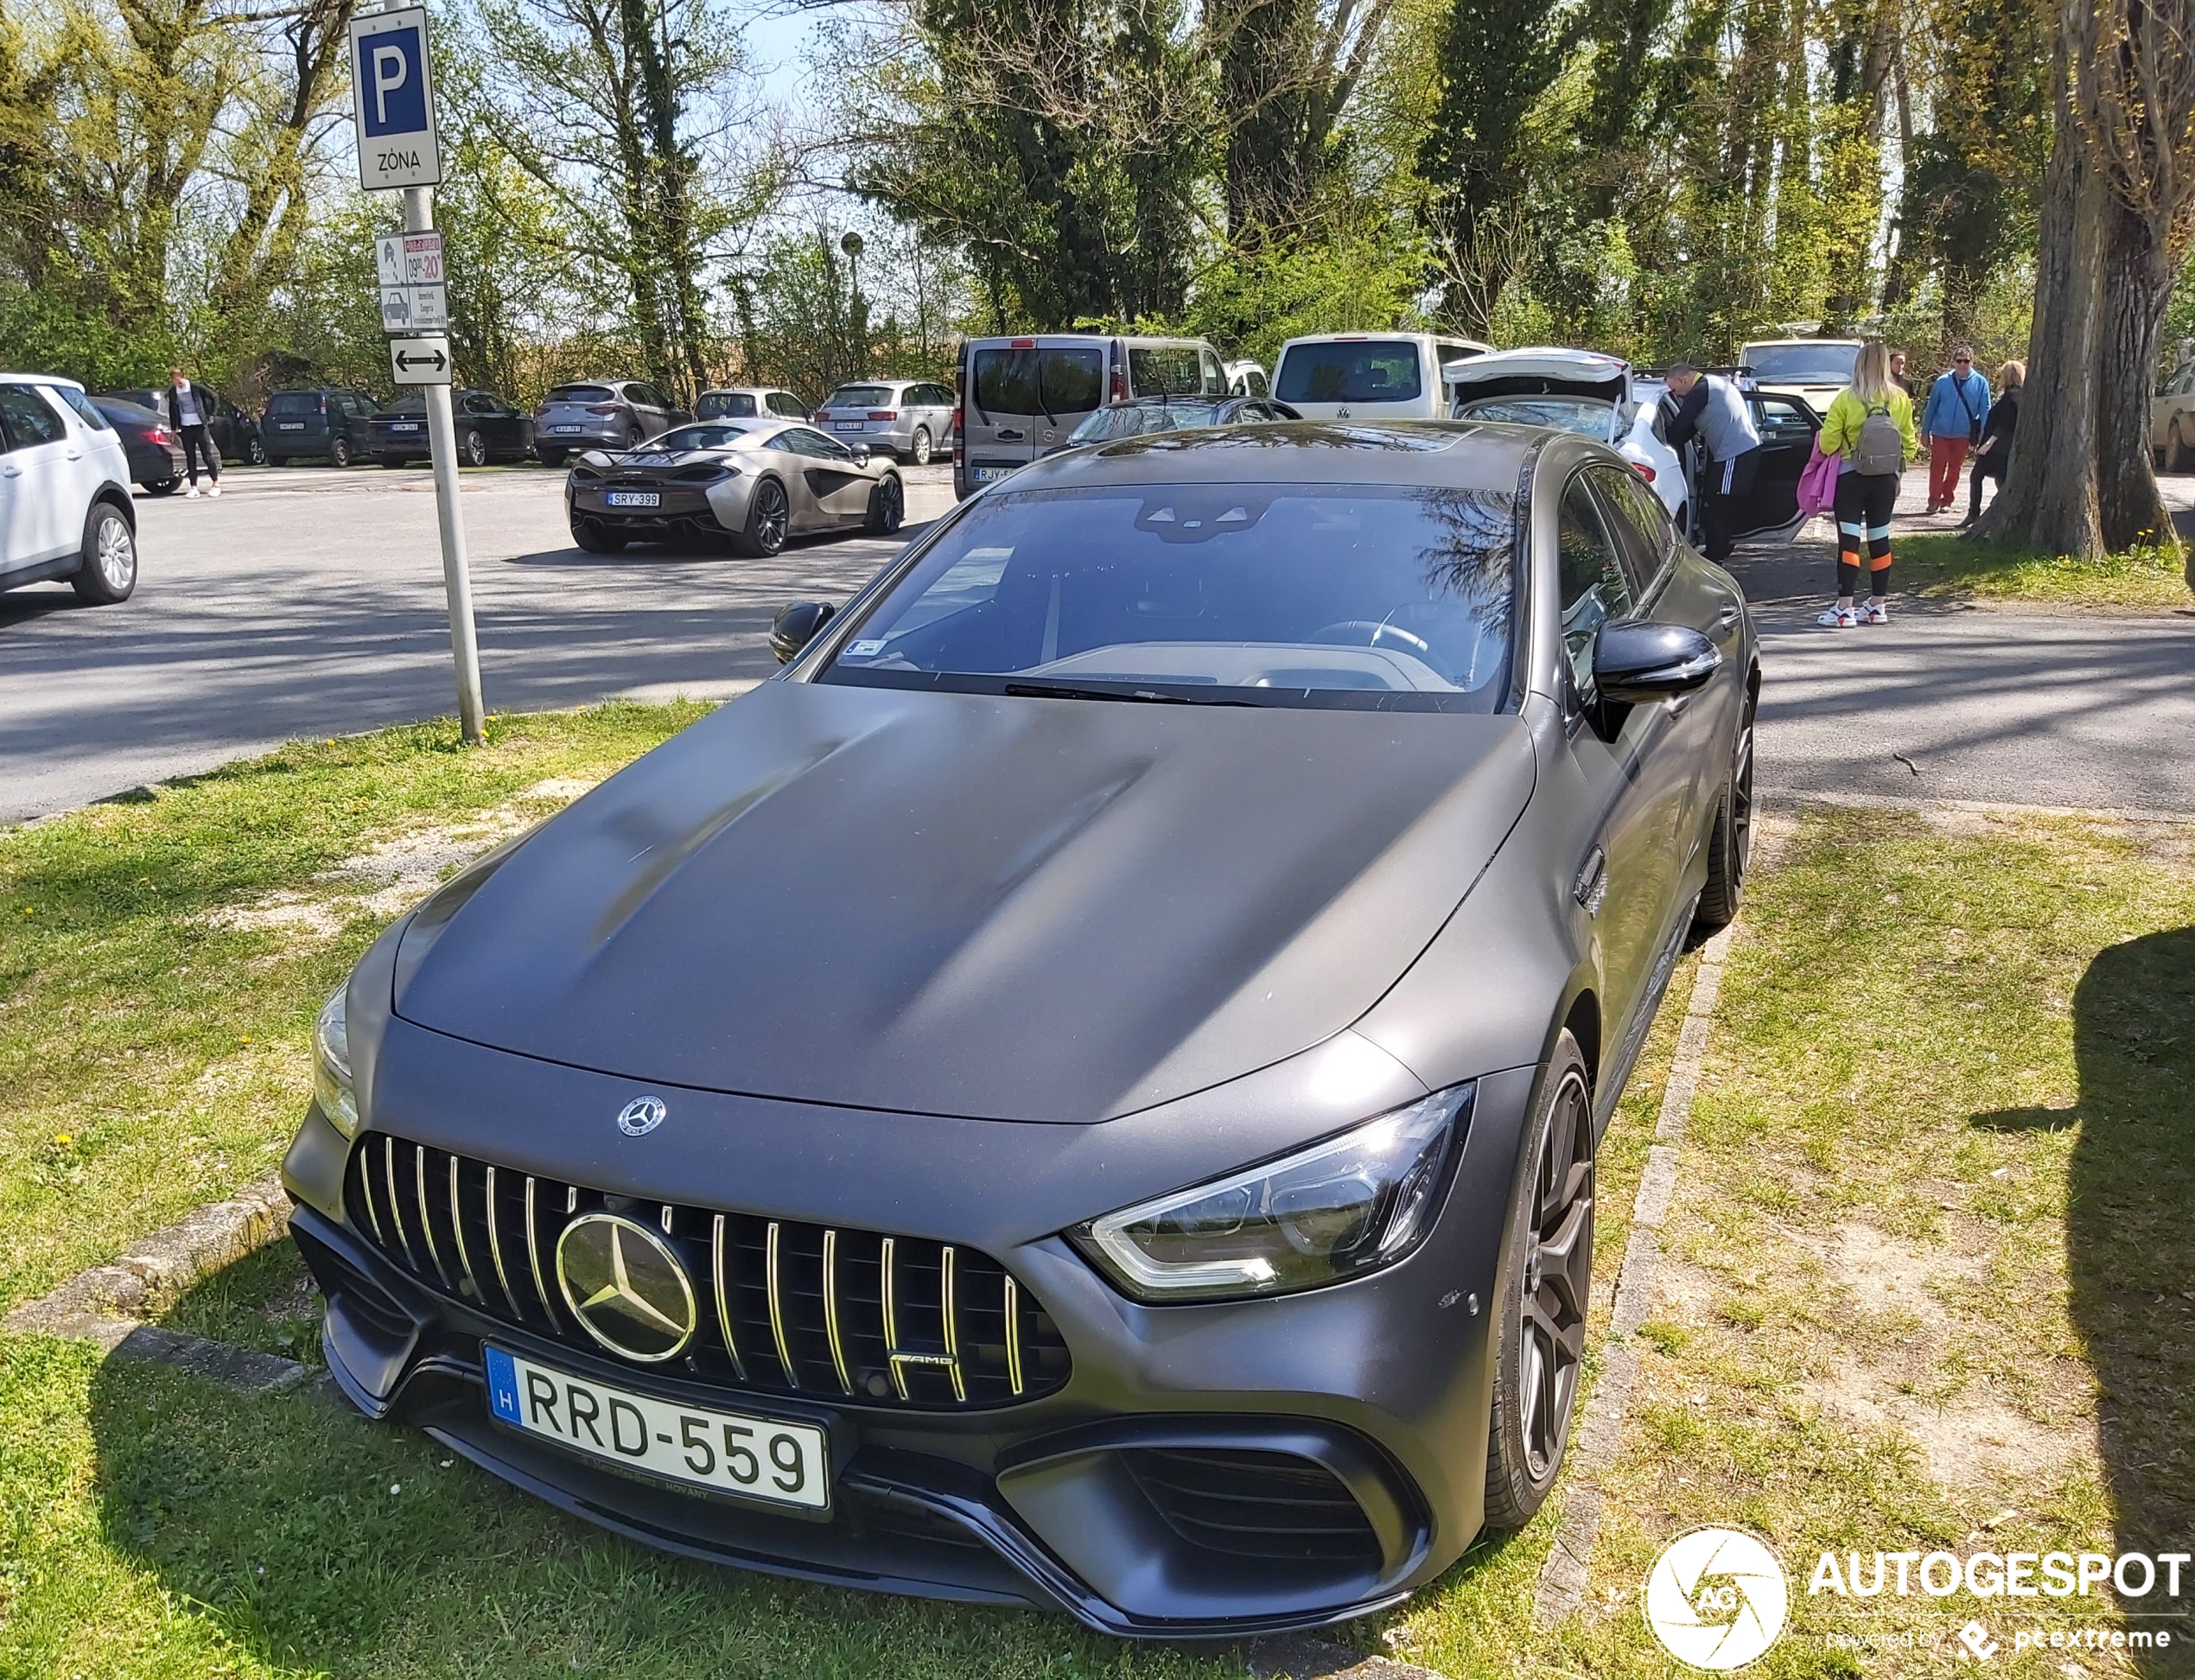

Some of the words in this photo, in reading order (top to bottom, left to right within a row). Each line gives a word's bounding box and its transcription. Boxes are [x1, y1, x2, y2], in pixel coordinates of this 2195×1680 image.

[372, 45, 408, 124] P
[377, 147, 422, 172] ZÓNA
[981, 470, 1014, 480] RJY-5
[614, 494, 657, 506] SRY-399
[910, 1355, 953, 1365] AMG
[499, 1389, 513, 1412] H
[525, 1369, 805, 1493] RRD-559
